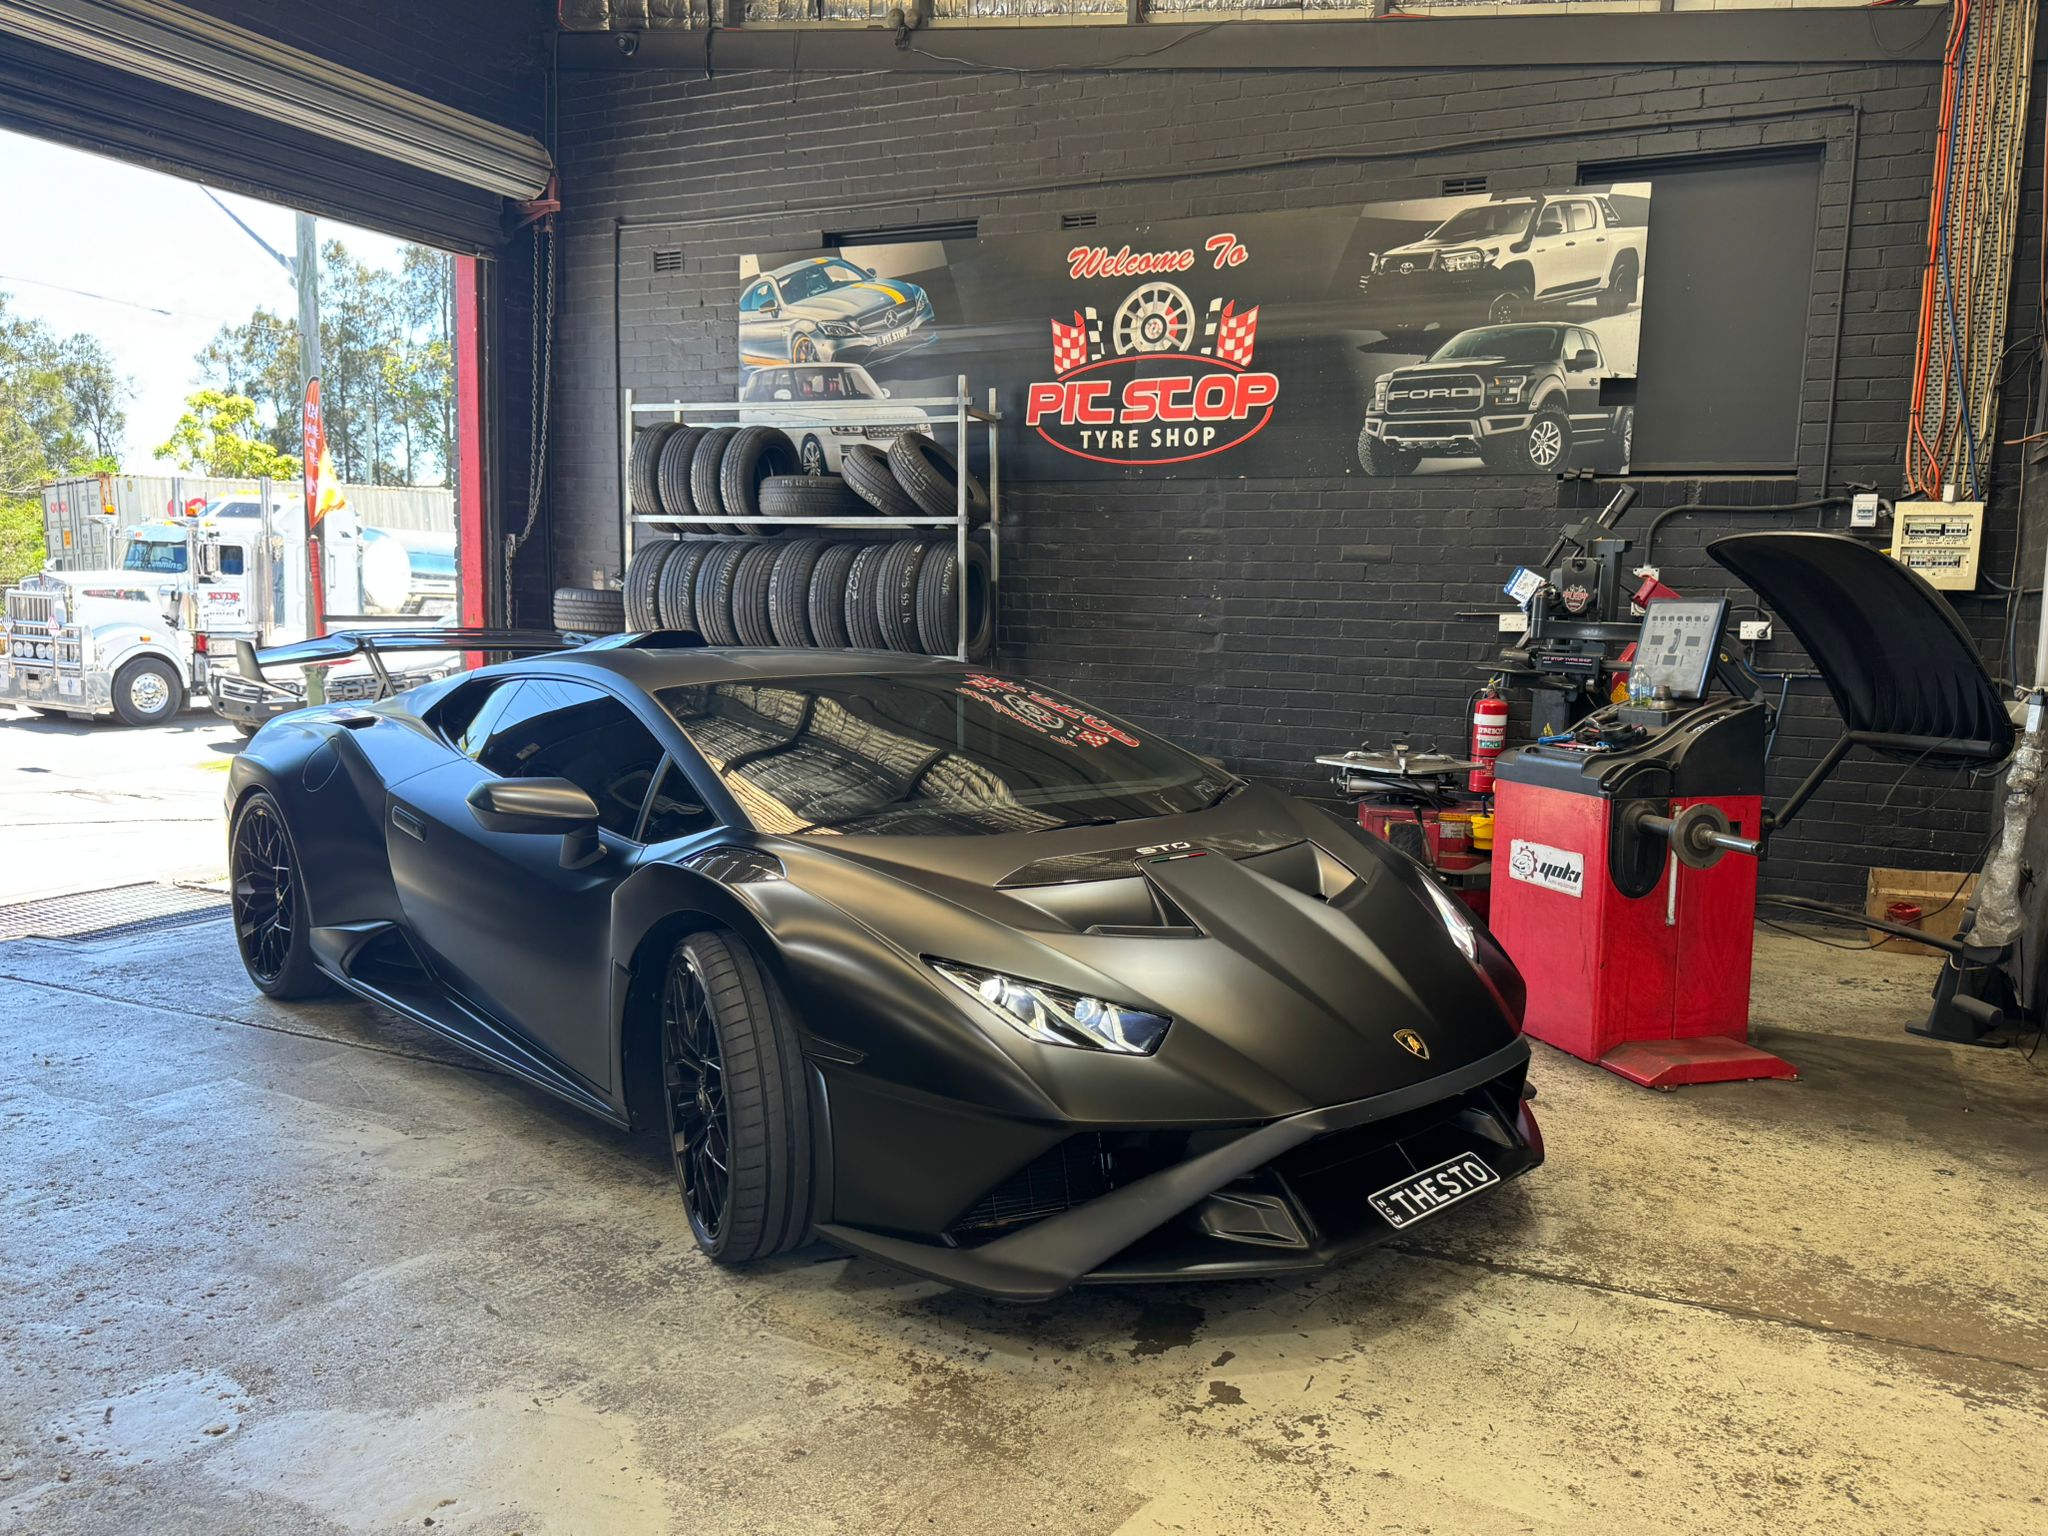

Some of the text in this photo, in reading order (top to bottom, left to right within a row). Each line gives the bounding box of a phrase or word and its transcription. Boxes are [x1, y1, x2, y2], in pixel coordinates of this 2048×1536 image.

[1067, 233, 1249, 279] Welcome To
[1026, 372, 1279, 425] PIT STOP
[1392, 387, 1473, 400] FORD
[1080, 427, 1216, 449] TYRE SHOP
[1389, 1161, 1488, 1215] THESTO
